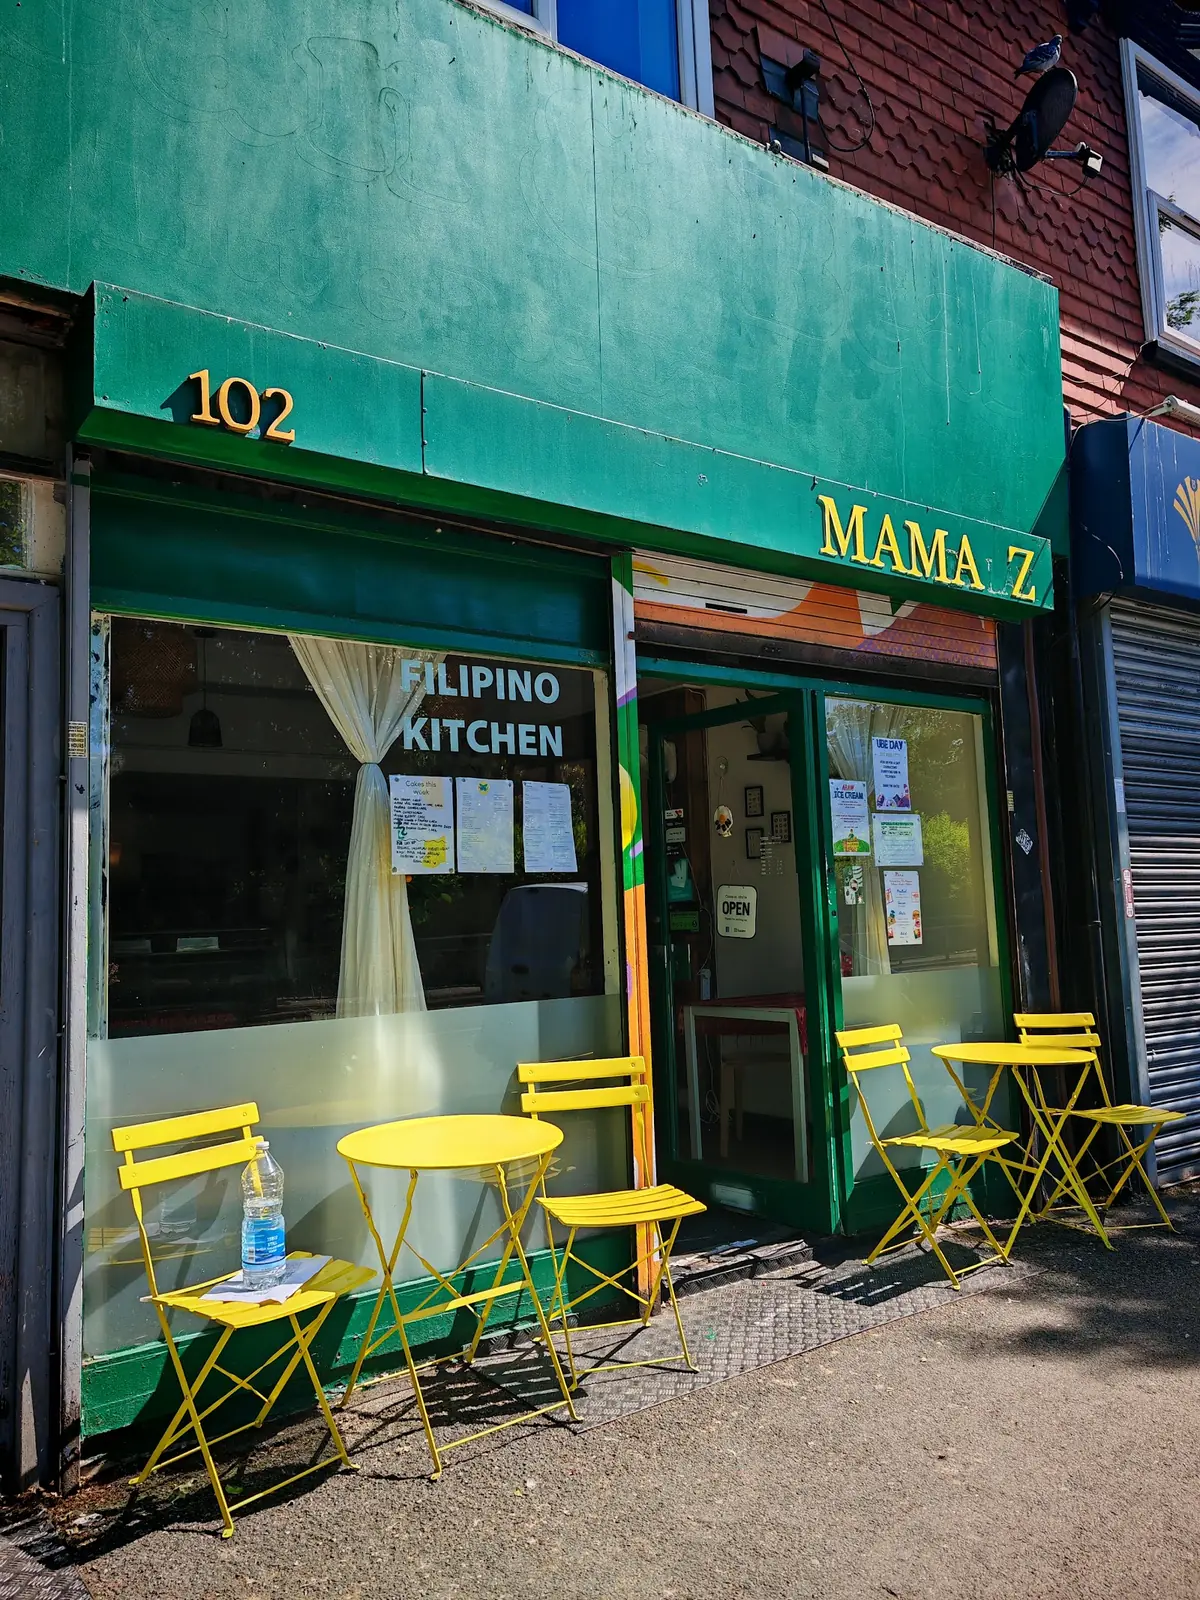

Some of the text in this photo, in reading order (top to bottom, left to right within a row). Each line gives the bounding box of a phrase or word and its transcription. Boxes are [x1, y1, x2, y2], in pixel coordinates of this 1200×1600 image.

[189, 368, 296, 442] 102
[817, 495, 1036, 602] MAMA Z
[400, 658, 560, 704] FILIPINO
[402, 716, 564, 757] KITCHEN
[876, 738, 904, 751] UBE DAY
[405, 780, 425, 788] Cakes
[834, 790, 864, 800] ICE CREAM
[722, 901, 750, 916] OPEN
